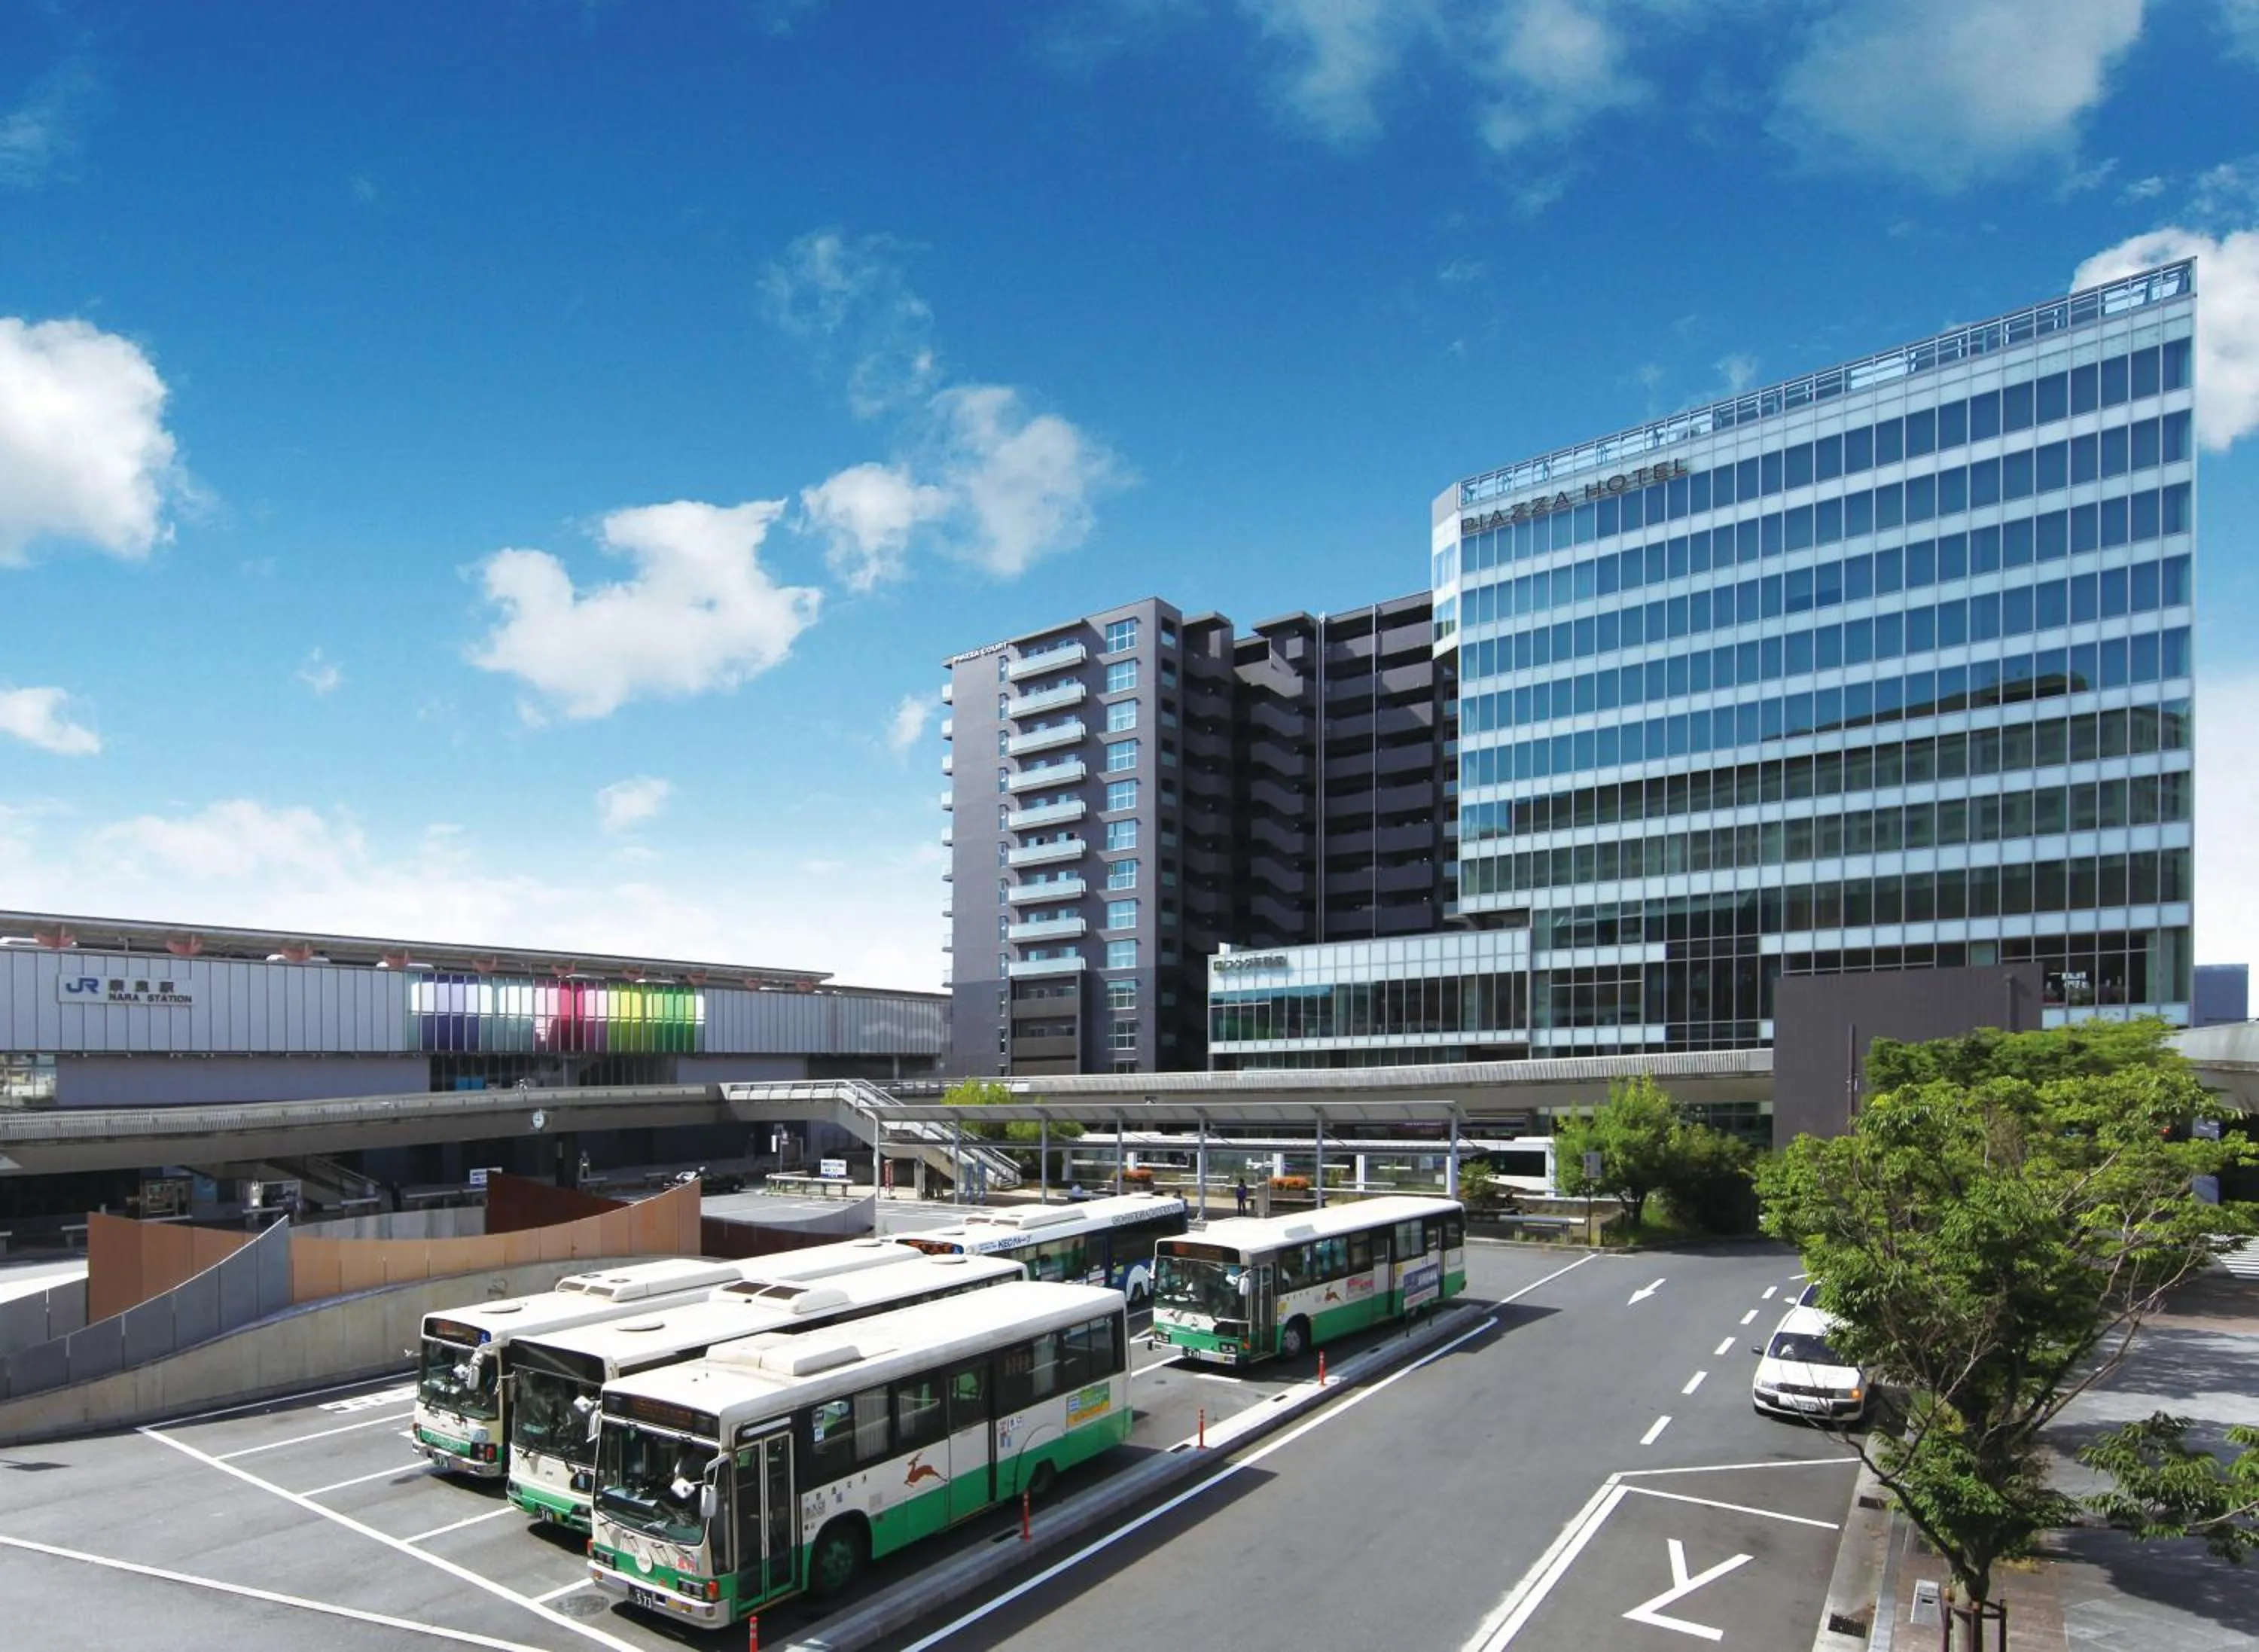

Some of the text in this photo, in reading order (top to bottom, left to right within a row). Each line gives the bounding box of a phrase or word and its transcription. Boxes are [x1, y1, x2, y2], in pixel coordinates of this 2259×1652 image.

[1461, 459, 1688, 530] PIAZZA HOTEL
[66, 977, 99, 994] JR
[108, 993, 193, 1003] NARA STATION
